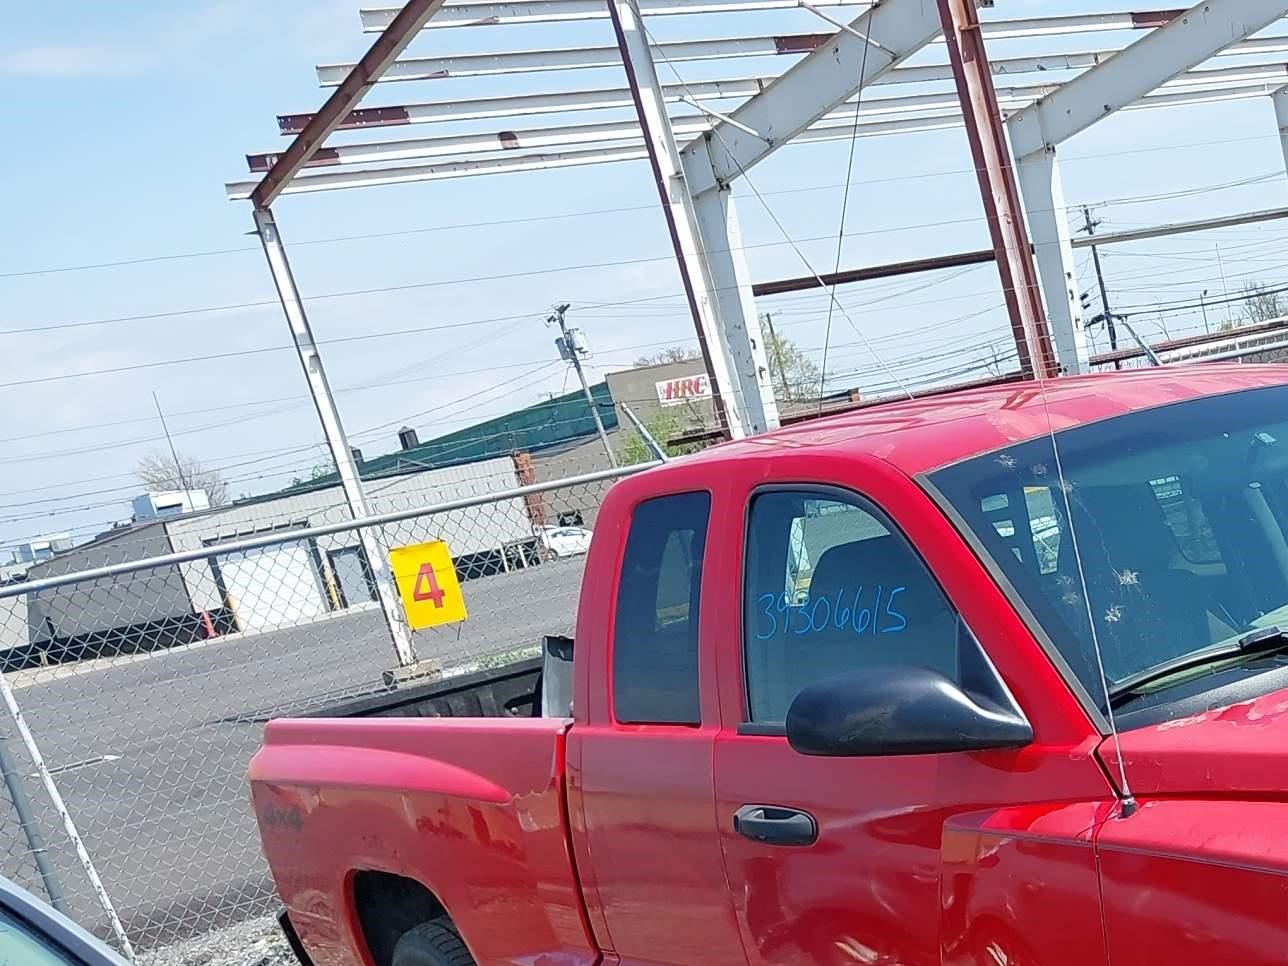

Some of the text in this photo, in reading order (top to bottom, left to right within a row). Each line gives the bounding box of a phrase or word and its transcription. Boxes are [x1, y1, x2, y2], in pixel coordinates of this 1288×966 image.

[665, 376, 705, 400] HRC
[413, 562, 446, 609] 4
[757, 585, 907, 640] 39306615
